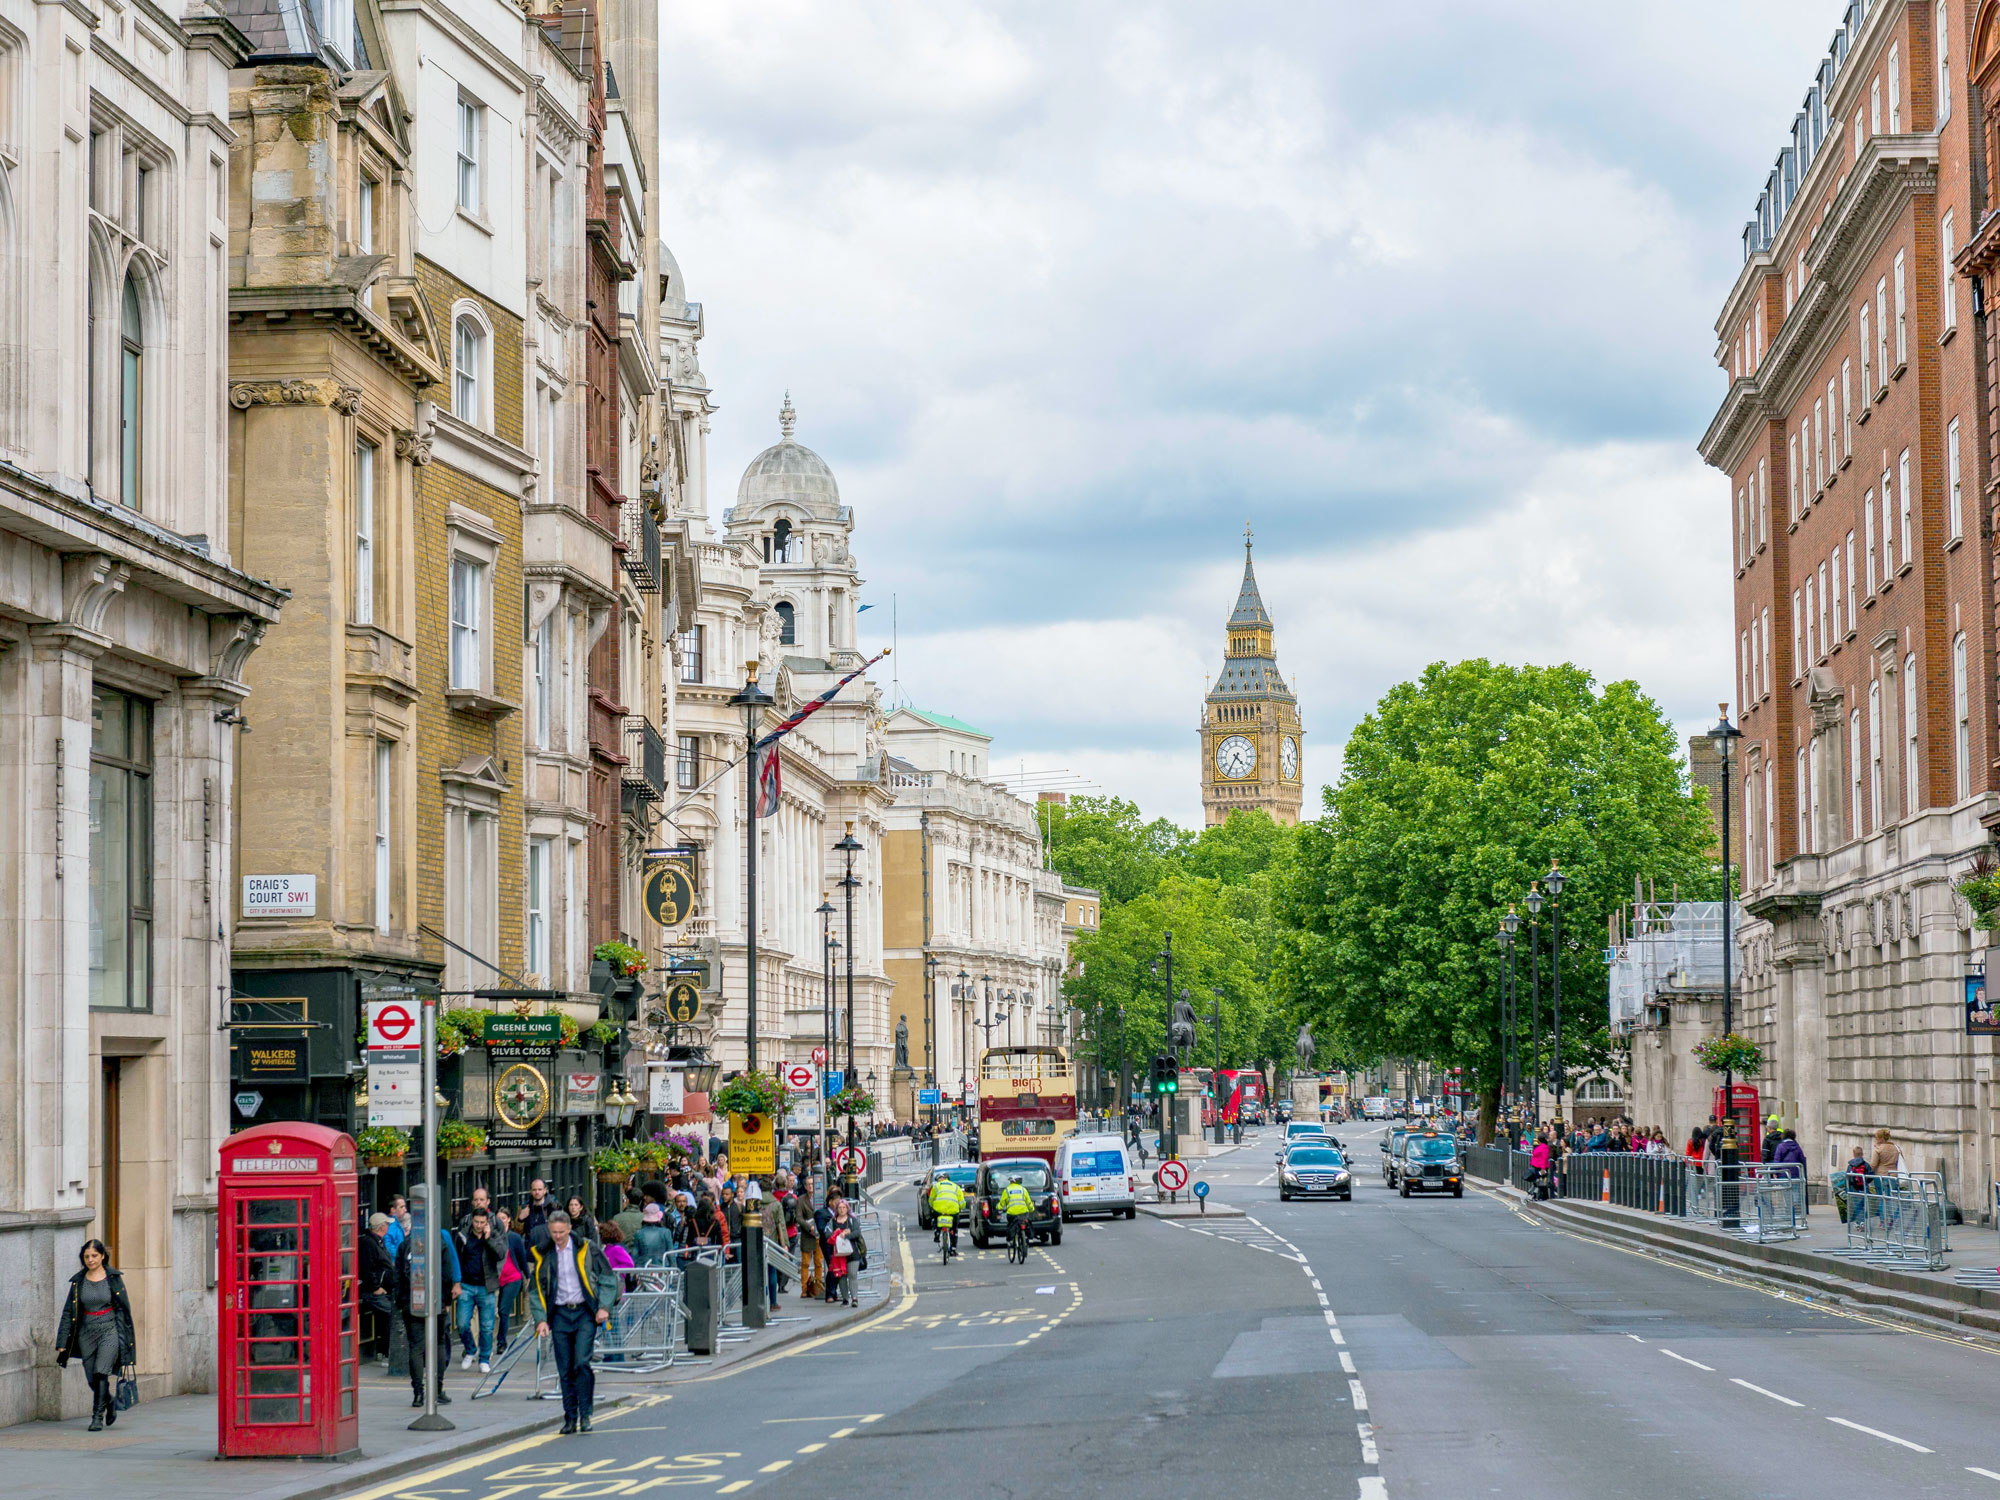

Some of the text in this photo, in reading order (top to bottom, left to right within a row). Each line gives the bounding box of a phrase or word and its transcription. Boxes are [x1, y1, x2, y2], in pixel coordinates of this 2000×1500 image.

[249, 879, 289, 890] CRAIG'S
[249, 892, 309, 903] COURT SW1
[491, 1023, 552, 1032] GREENE KING
[250, 1050, 297, 1059] WALKERS
[491, 1047, 551, 1056] SILVER CROSS
[814, 1049, 826, 1061] M
[1012, 1078, 1029, 1087] BIG
[489, 1138, 553, 1147] DOWNSTAIRS BAR
[733, 1145, 771, 1153] 11th JUNE
[238, 1159, 315, 1171] TELEPHONE
[482, 1452, 742, 1480] BUS
